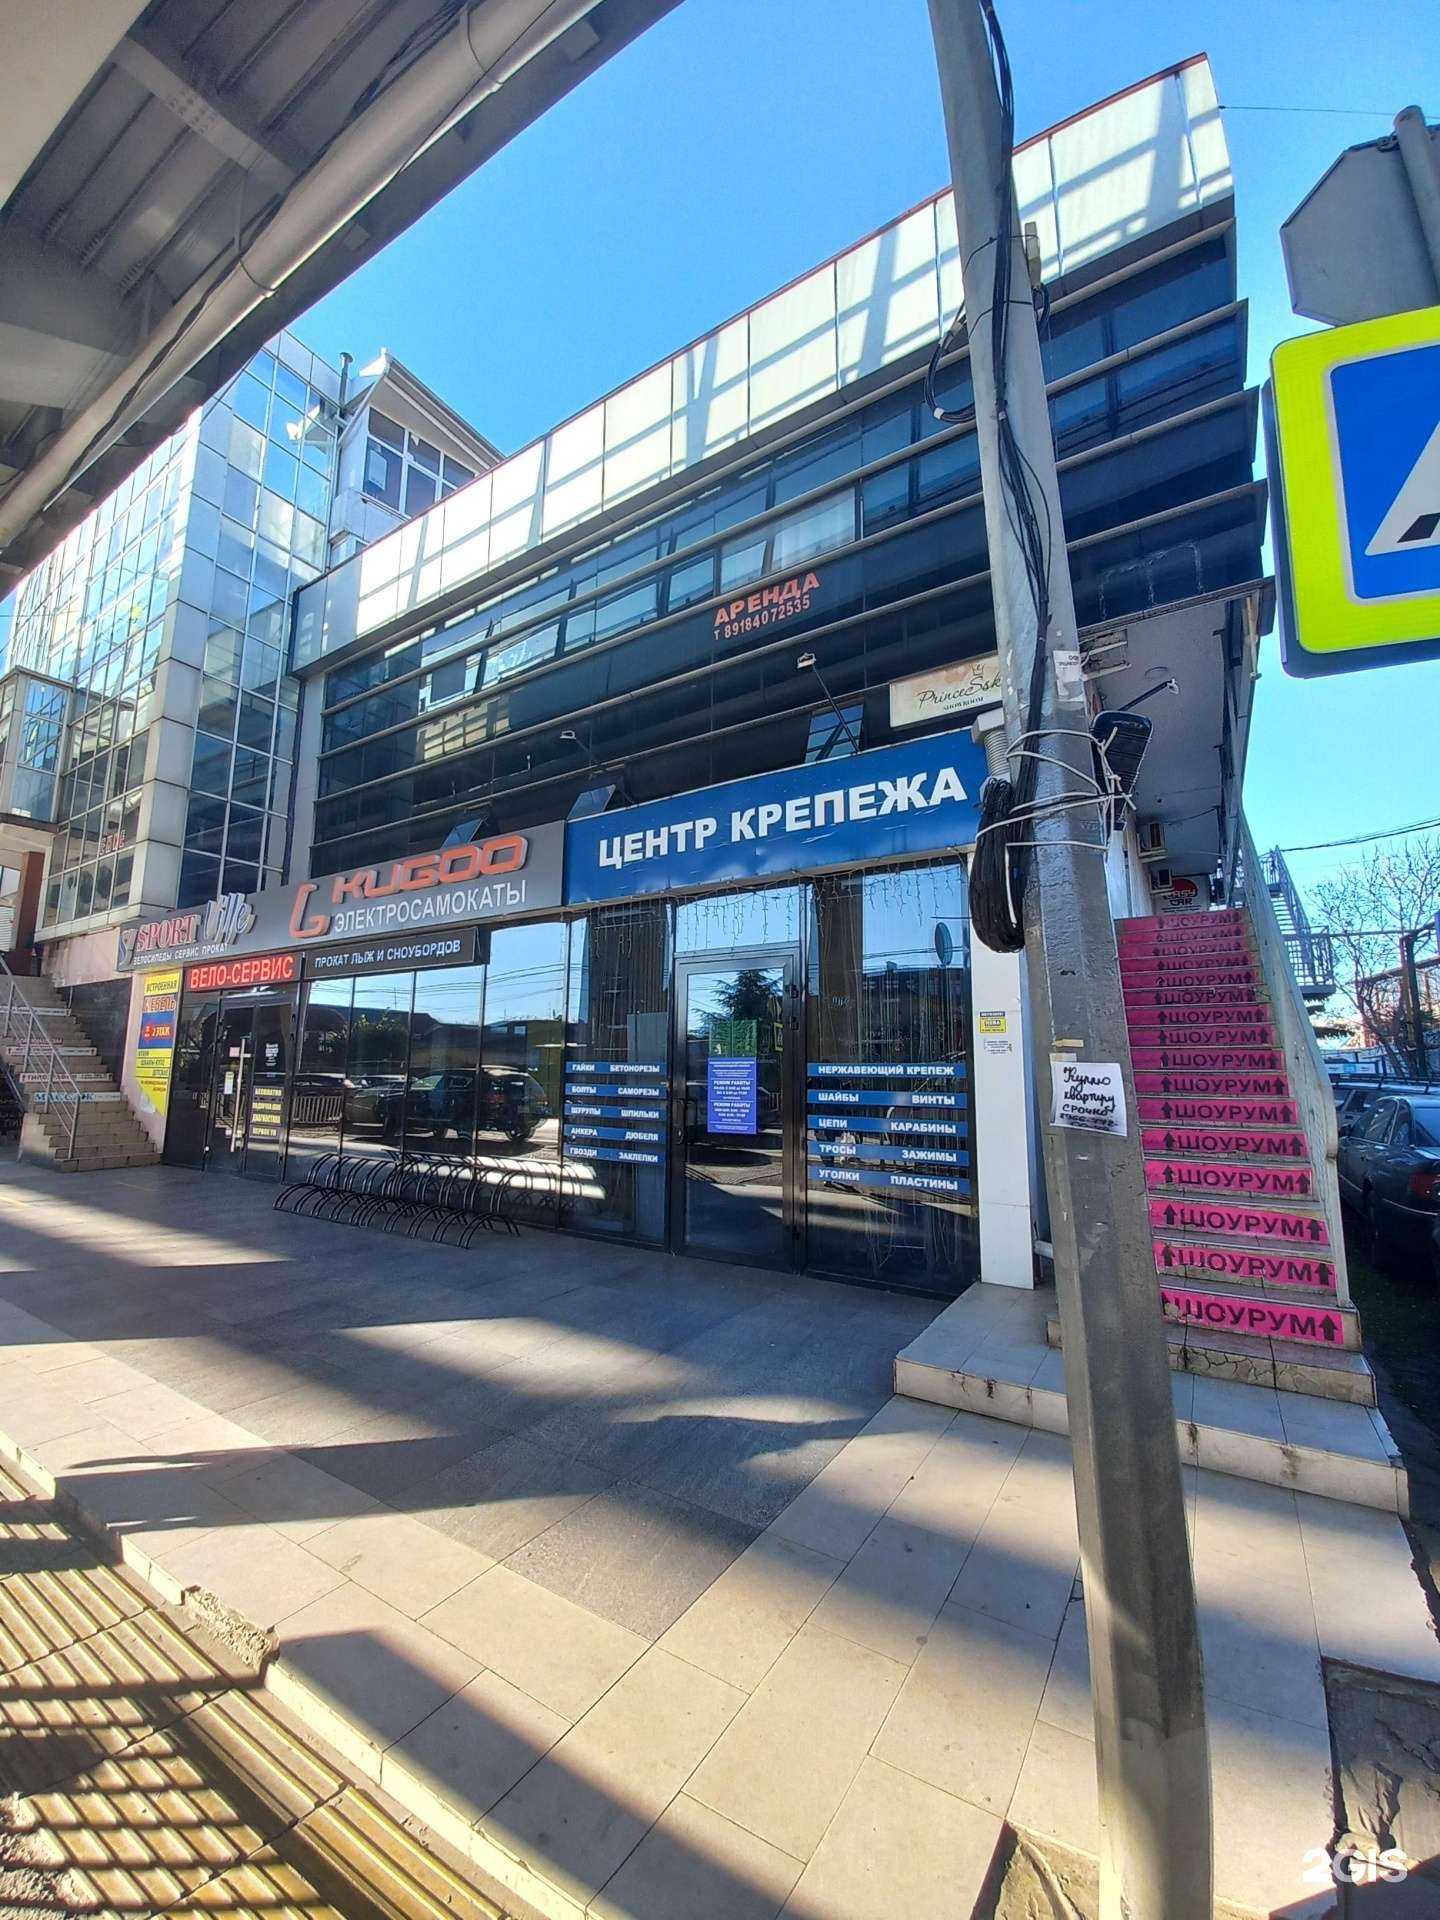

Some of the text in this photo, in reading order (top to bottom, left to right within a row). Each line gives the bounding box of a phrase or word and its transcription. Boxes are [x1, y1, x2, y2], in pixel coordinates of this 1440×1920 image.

[714, 572, 820, 626] АРЕНДА
[599, 766, 968, 870] ЦЕНТР КРЕПЕЖА
[331, 834, 528, 904] KUGOO
[334, 880, 526, 933] ЭЛЕКТРОСАМОКАТЫ
[137, 913, 201, 952] SPORT
[134, 944, 229, 966] ВЕЛОСИПЕДЫ СЕРВИС ПРОКАТ
[315, 940, 461, 968] ПРОКАТ ЛЫЖ И СНОУБОРДОВ
[190, 956, 294, 988] ВЕЛО-СЕРВИС
[1166, 973, 1241, 986] ШОУРУМ
[1169, 1010, 1252, 1023] ШОУРУМ
[1169, 1030, 1256, 1044] ШОУРУМ
[572, 1064, 660, 1072] ГАЙКИ БЕТОНОРЕЗЫ
[1172, 1054, 1266, 1067] ШОУРУМ
[818, 1065, 954, 1076] НЕРЖАВЕЮЩИЙ КРЕПЕЖ
[1064, 1067, 1111, 1092] Куплю
[572, 1086, 660, 1096] БОЛТЫ САМОРЕЗЫ
[1174, 1078, 1271, 1094] ШОУРУМ
[818, 1092, 955, 1105] ШАЙБЫ ВИНТЫ
[1064, 1086, 1116, 1112] квартиру
[570, 1106, 659, 1119] ШУРУПЫ ШПИЛЬКИ
[1175, 1104, 1278, 1122] ШОУРУМ
[571, 1127, 658, 1142] АНКЕРА ДЮБЕЛЯ
[818, 1118, 956, 1134] ЦЕПИ КАРАБИНЫ
[820, 1144, 956, 1162] ТРОСЫ ЗАЖИМЫ
[1178, 1135, 1286, 1154] ШОУРУМ
[570, 1147, 658, 1163] ГВОЗДИ ЗАКЛЕПКИ
[818, 1169, 958, 1190] УГОЛКИ ПЛАСТИНЫ
[1178, 1170, 1294, 1192] ШОУРУМ
[1180, 1208, 1305, 1238] ШОУРУМ
[1178, 1249, 1312, 1282] ШОУРУМ
